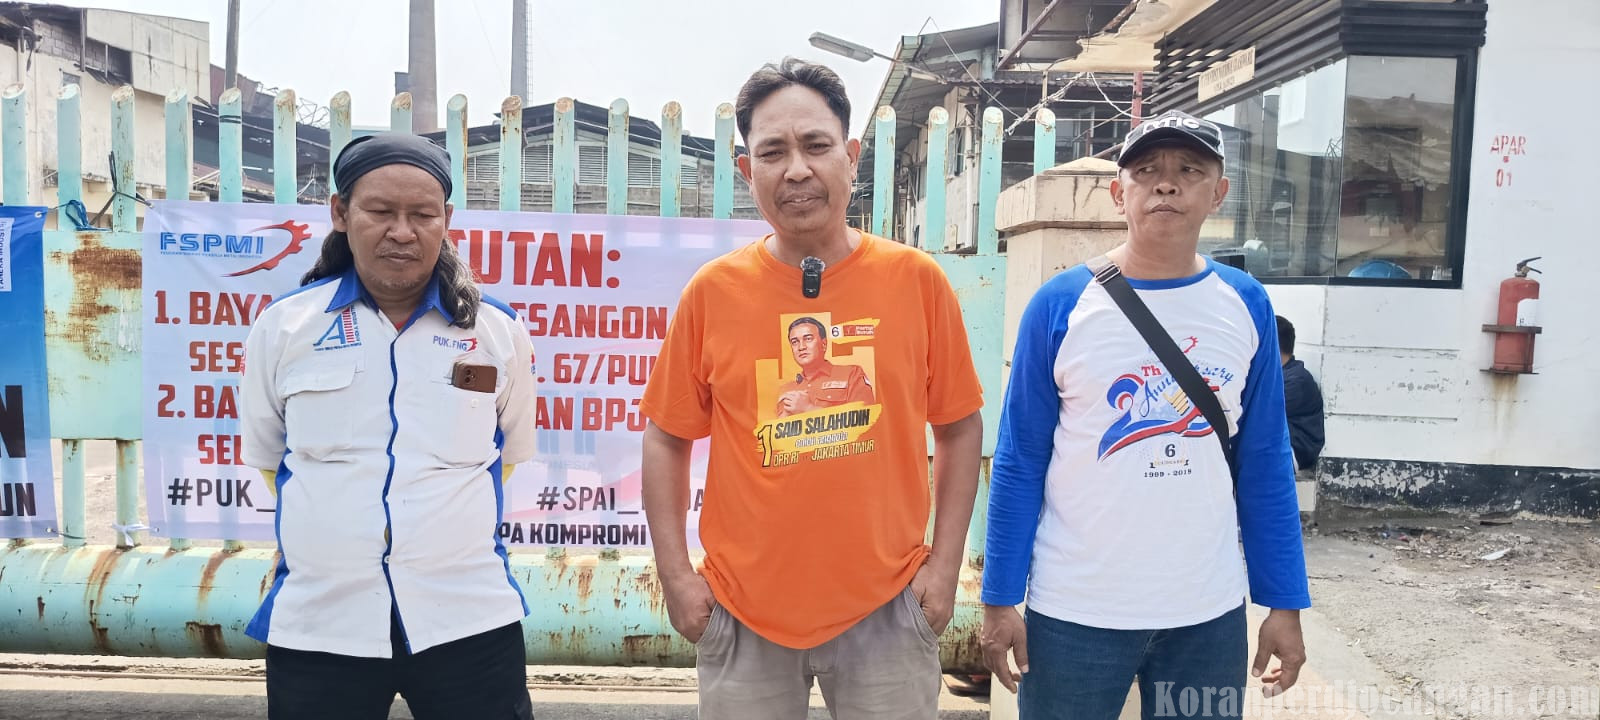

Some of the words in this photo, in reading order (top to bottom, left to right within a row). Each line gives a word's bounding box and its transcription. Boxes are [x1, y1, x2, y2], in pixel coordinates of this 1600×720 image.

[1490, 136, 1526, 155] APAR
[1496, 168, 1512, 187] 01
[160, 231, 264, 254] FSPMI
[448, 229, 621, 288] UTAN:
[155, 290, 181, 324] 1.
[831, 326, 840, 338] 6
[554, 353, 657, 386] 67/PU
[157, 384, 186, 418] 2.
[194, 385, 240, 419] BA
[757, 424, 773, 468] 1
[774, 419, 803, 440] SAID
[804, 408, 871, 435] SALAHUDIN
[811, 441, 850, 462] JAKARTA
[851, 439, 875, 455] TIMUR
[1165, 443, 1176, 458] 6
[530, 523, 647, 546] KOMPROMI
